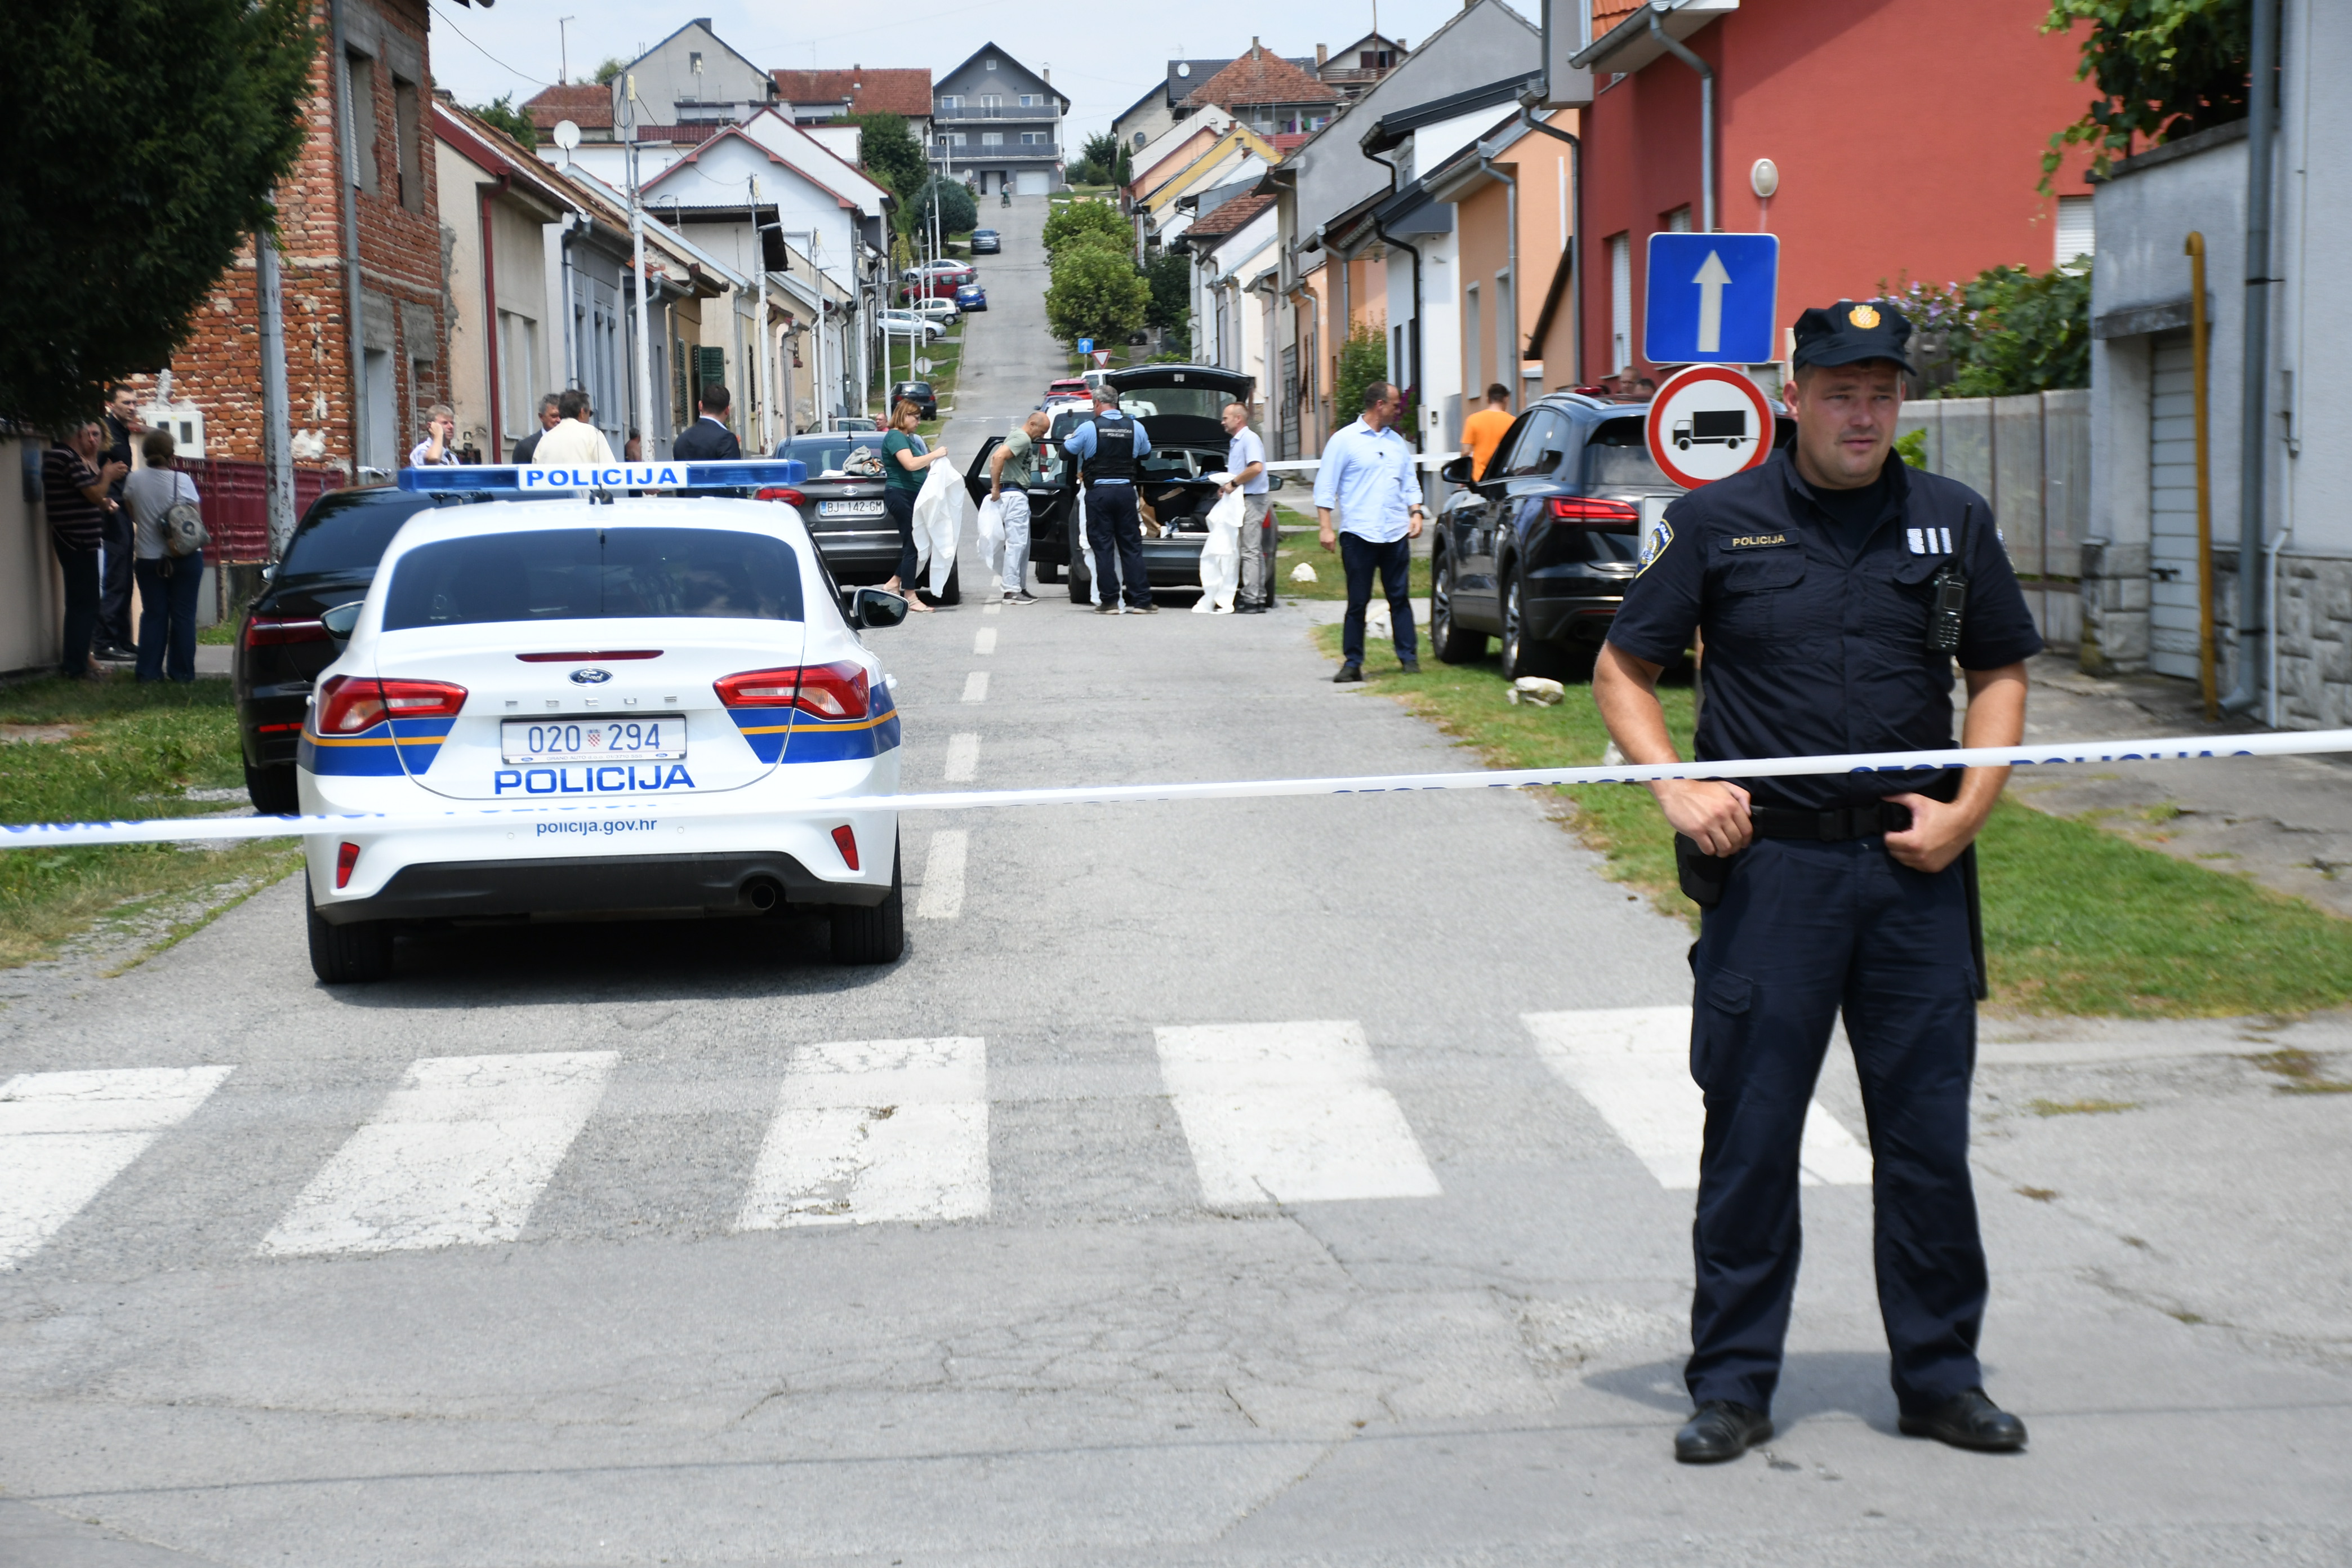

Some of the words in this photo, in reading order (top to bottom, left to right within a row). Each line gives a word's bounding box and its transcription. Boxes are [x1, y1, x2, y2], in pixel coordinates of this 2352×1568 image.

[526, 468, 679, 487] POLICIJA
[827, 502, 839, 513] BJ
[848, 501, 882, 512] 142-GM
[1732, 534, 1786, 547] POLICIJA
[577, 669, 604, 683] Ford
[528, 725, 581, 753] 020
[608, 723, 660, 751] 294
[494, 764, 696, 795] POLICIJA
[537, 819, 658, 837] policija.gov.hr
